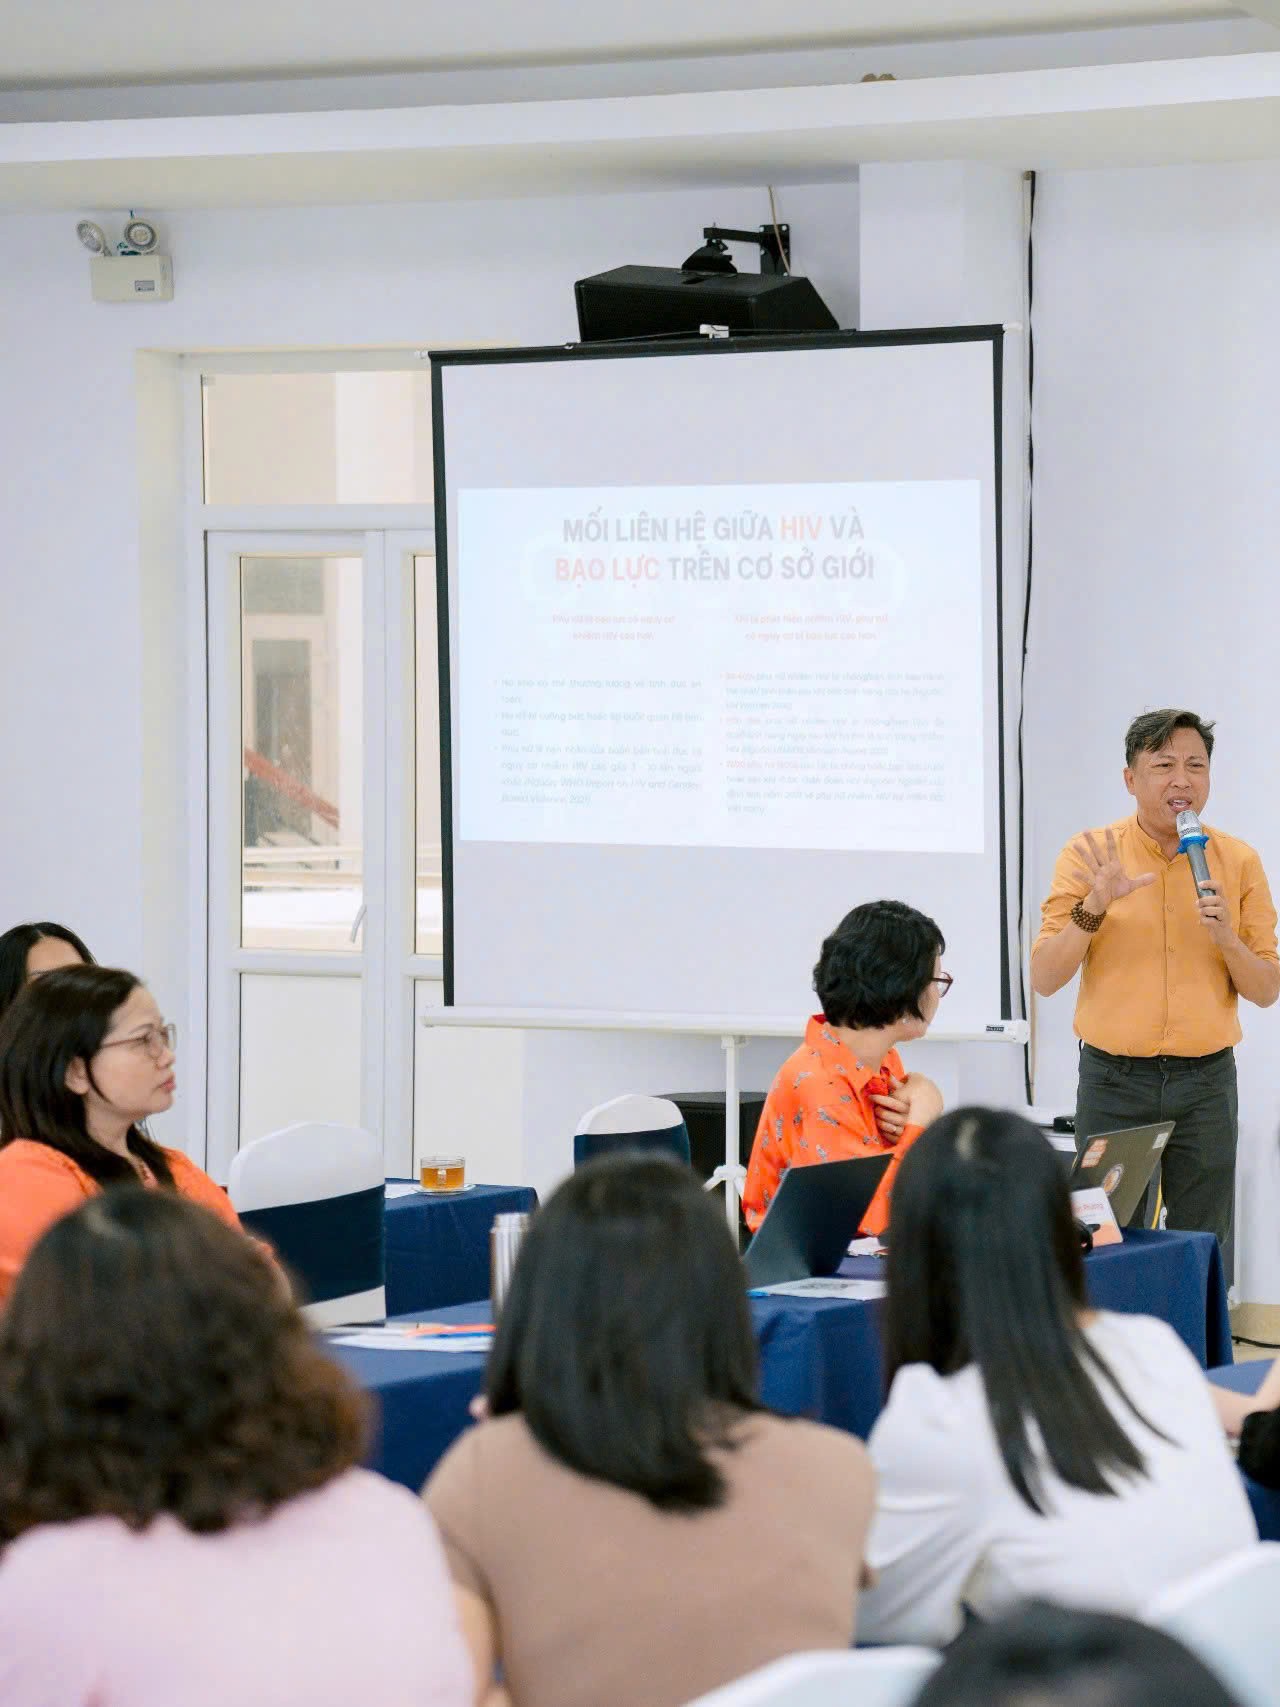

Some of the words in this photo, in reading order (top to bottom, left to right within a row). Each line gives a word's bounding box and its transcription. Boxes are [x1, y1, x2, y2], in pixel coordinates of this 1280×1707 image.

[564, 506, 608, 541] MỐI
[617, 511, 667, 541] LIÊN
[676, 511, 705, 549] HỆ
[714, 510, 773, 540] GIỮA
[781, 516, 821, 539] HIV
[830, 507, 864, 538] VÀ
[556, 557, 604, 588] BẠO
[613, 553, 658, 588] LỰC
[669, 550, 729, 580] TRÊN
[738, 553, 772, 579] CƠ
[782, 547, 814, 578] SỞ
[823, 547, 873, 579] GIỚI
